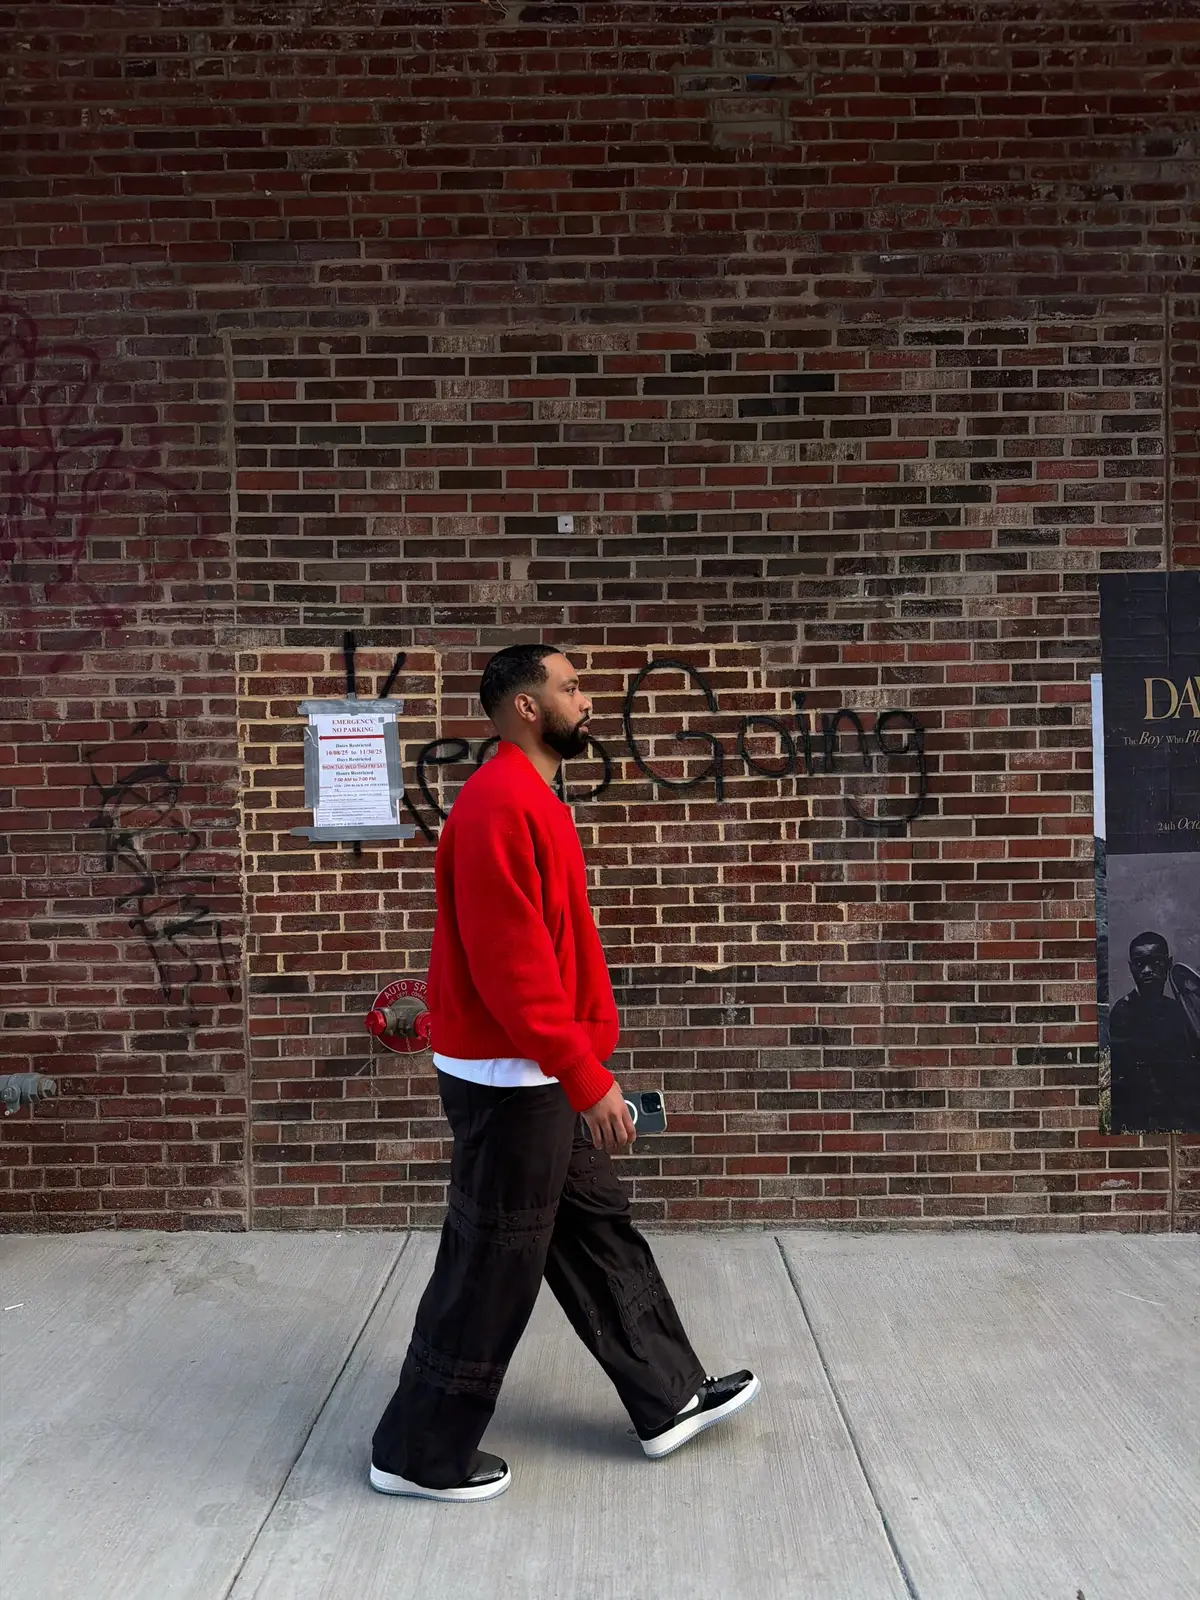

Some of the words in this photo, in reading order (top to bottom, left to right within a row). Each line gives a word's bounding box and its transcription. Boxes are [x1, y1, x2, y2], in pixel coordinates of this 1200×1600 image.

[1143, 675, 1200, 720] DA
[623, 659, 927, 827] Going
[1122, 736, 1137, 746] The
[1138, 731, 1164, 749] Boy
[1166, 735, 1184, 744] Who
[384, 982, 407, 999] AUTO
[413, 982, 427, 994] SP
